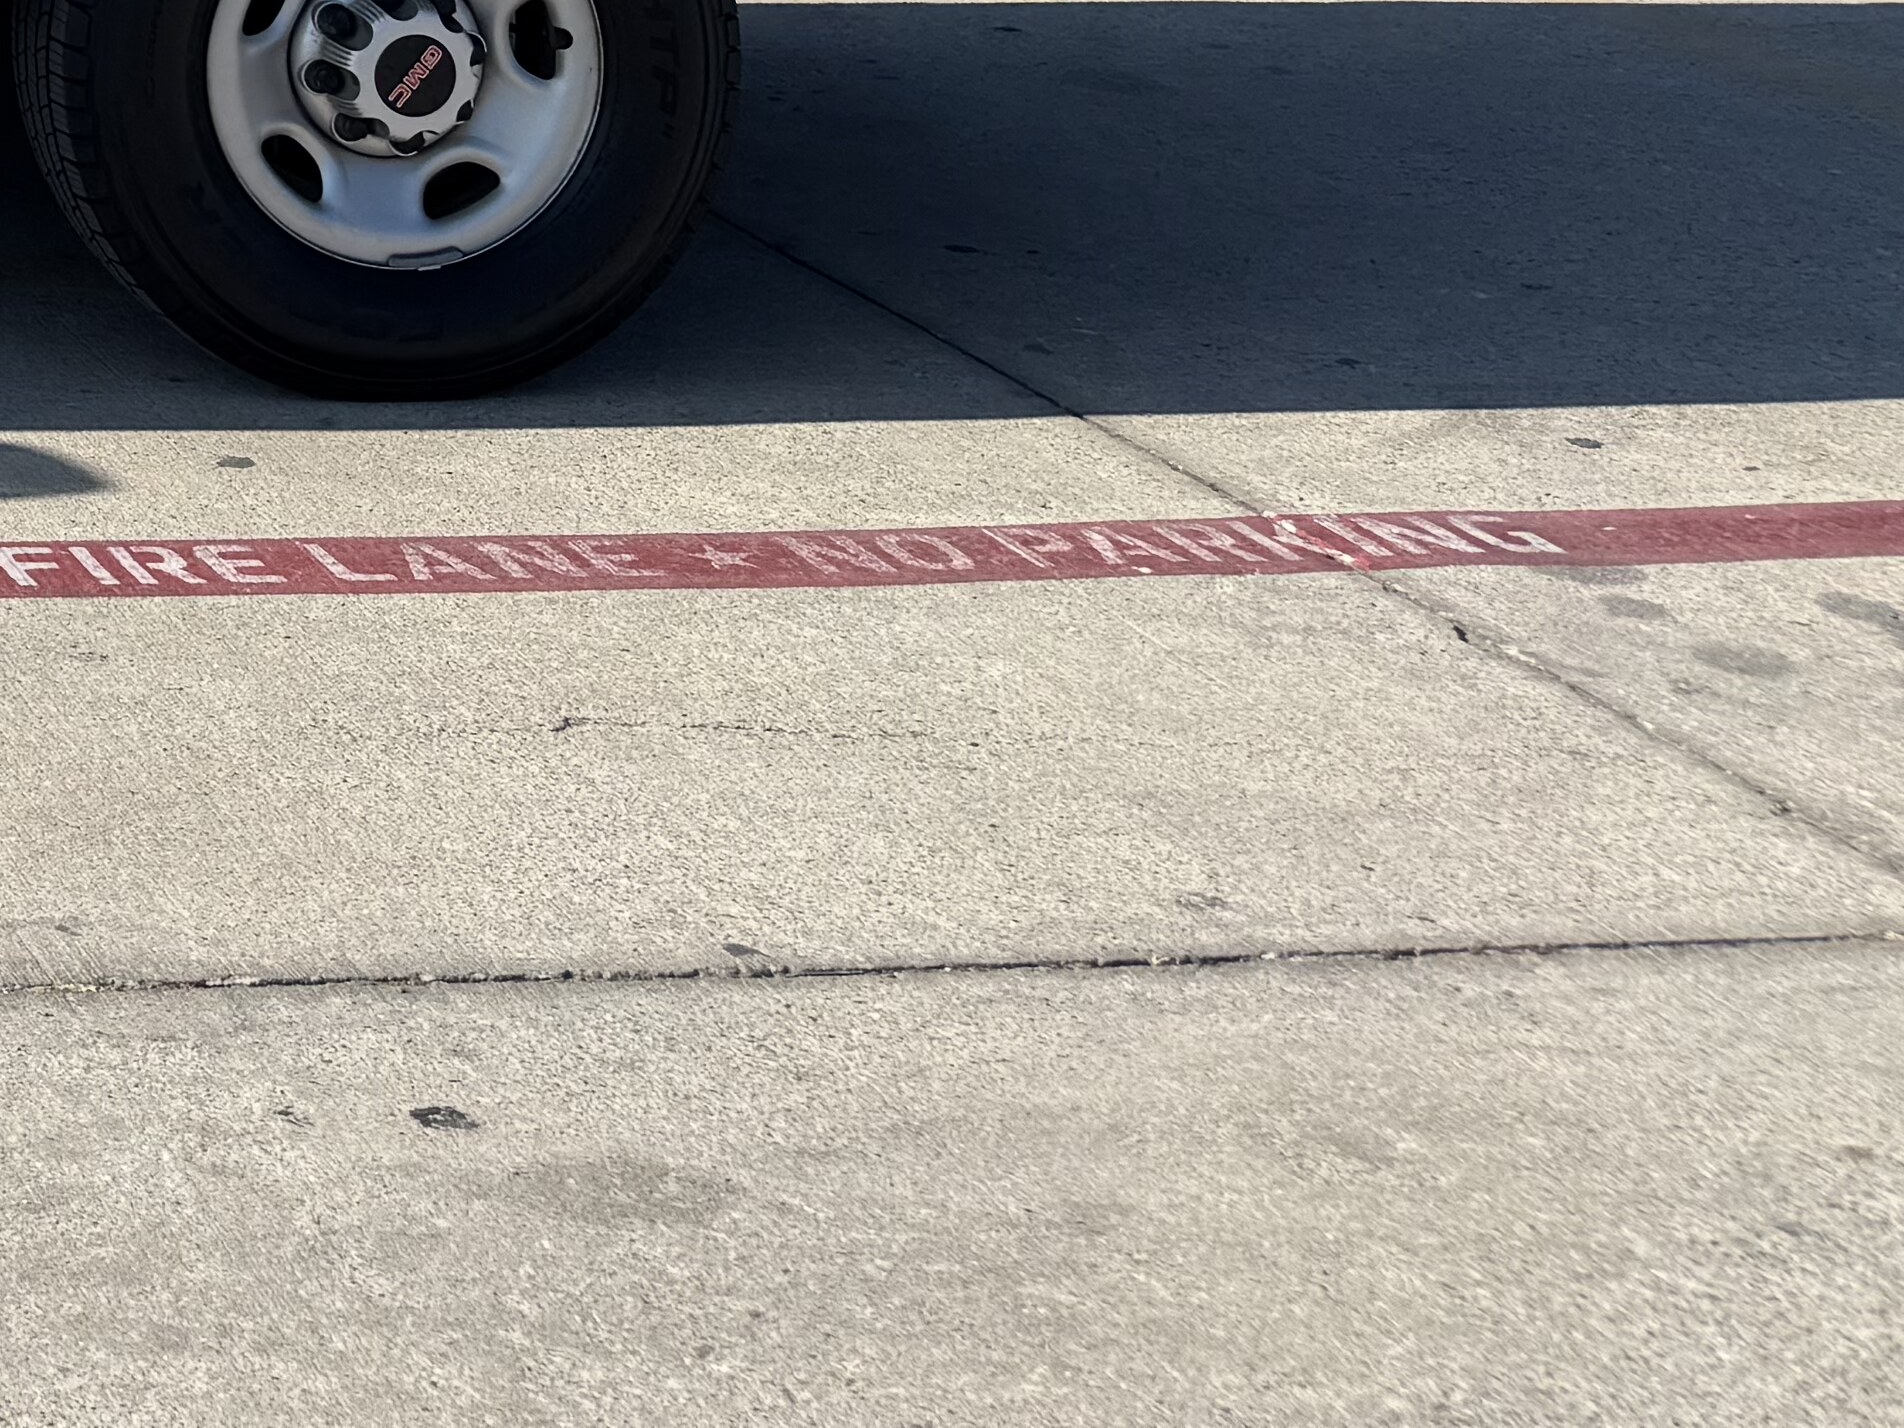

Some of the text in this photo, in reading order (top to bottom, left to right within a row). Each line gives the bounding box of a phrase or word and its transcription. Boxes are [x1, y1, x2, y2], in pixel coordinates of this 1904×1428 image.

[388, 44, 443, 109] GMC
[293, 539, 670, 582] LANE
[786, 530, 975, 577] NO
[980, 511, 1567, 567] PARKING
